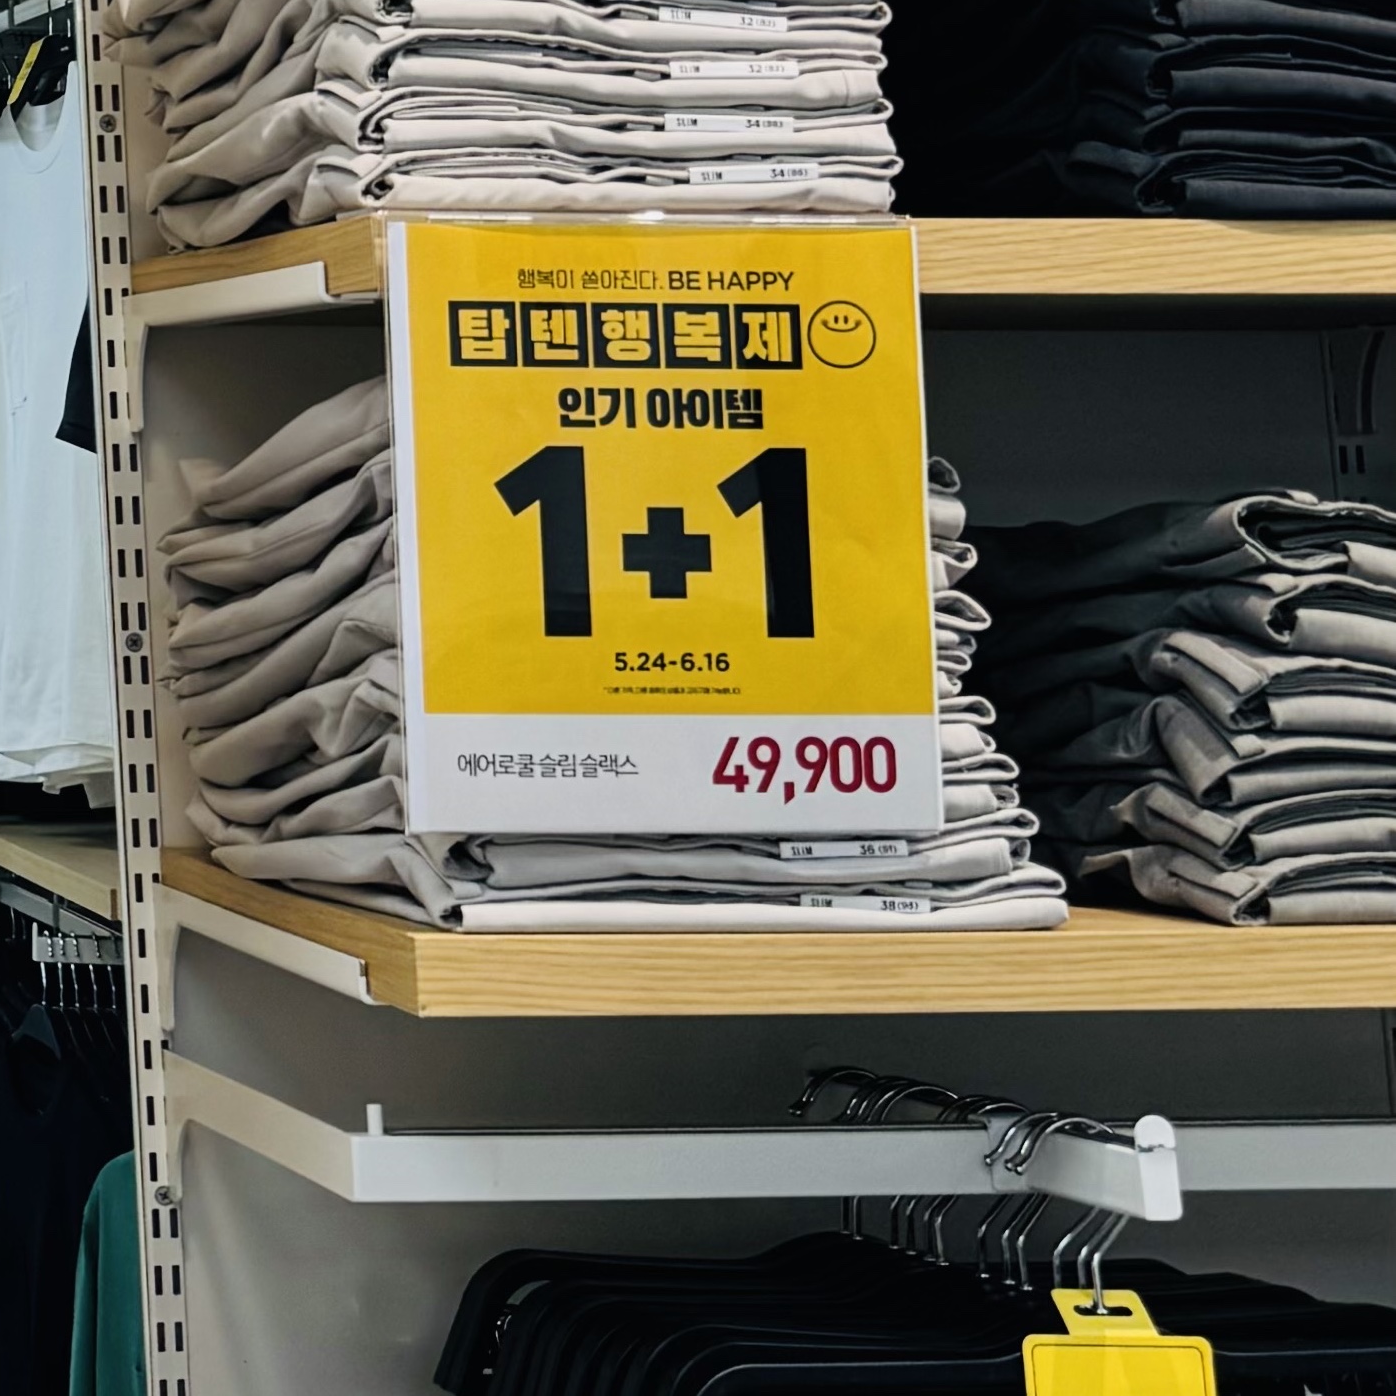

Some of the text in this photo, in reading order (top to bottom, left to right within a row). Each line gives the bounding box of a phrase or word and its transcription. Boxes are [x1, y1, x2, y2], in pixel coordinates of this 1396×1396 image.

[517, 268, 576, 290] 행복이
[667, 271, 702, 291] BE
[707, 271, 795, 292] HAPPY
[448, 301, 803, 369] 탑텐행복제
[557, 387, 764, 430] 인기 아이템
[493, 445, 815, 638] 1+1
[613, 651, 731, 673] 5.24-6.16
[579, 753, 639, 778] 슬랙스
[712, 735, 897, 804] 49,900
